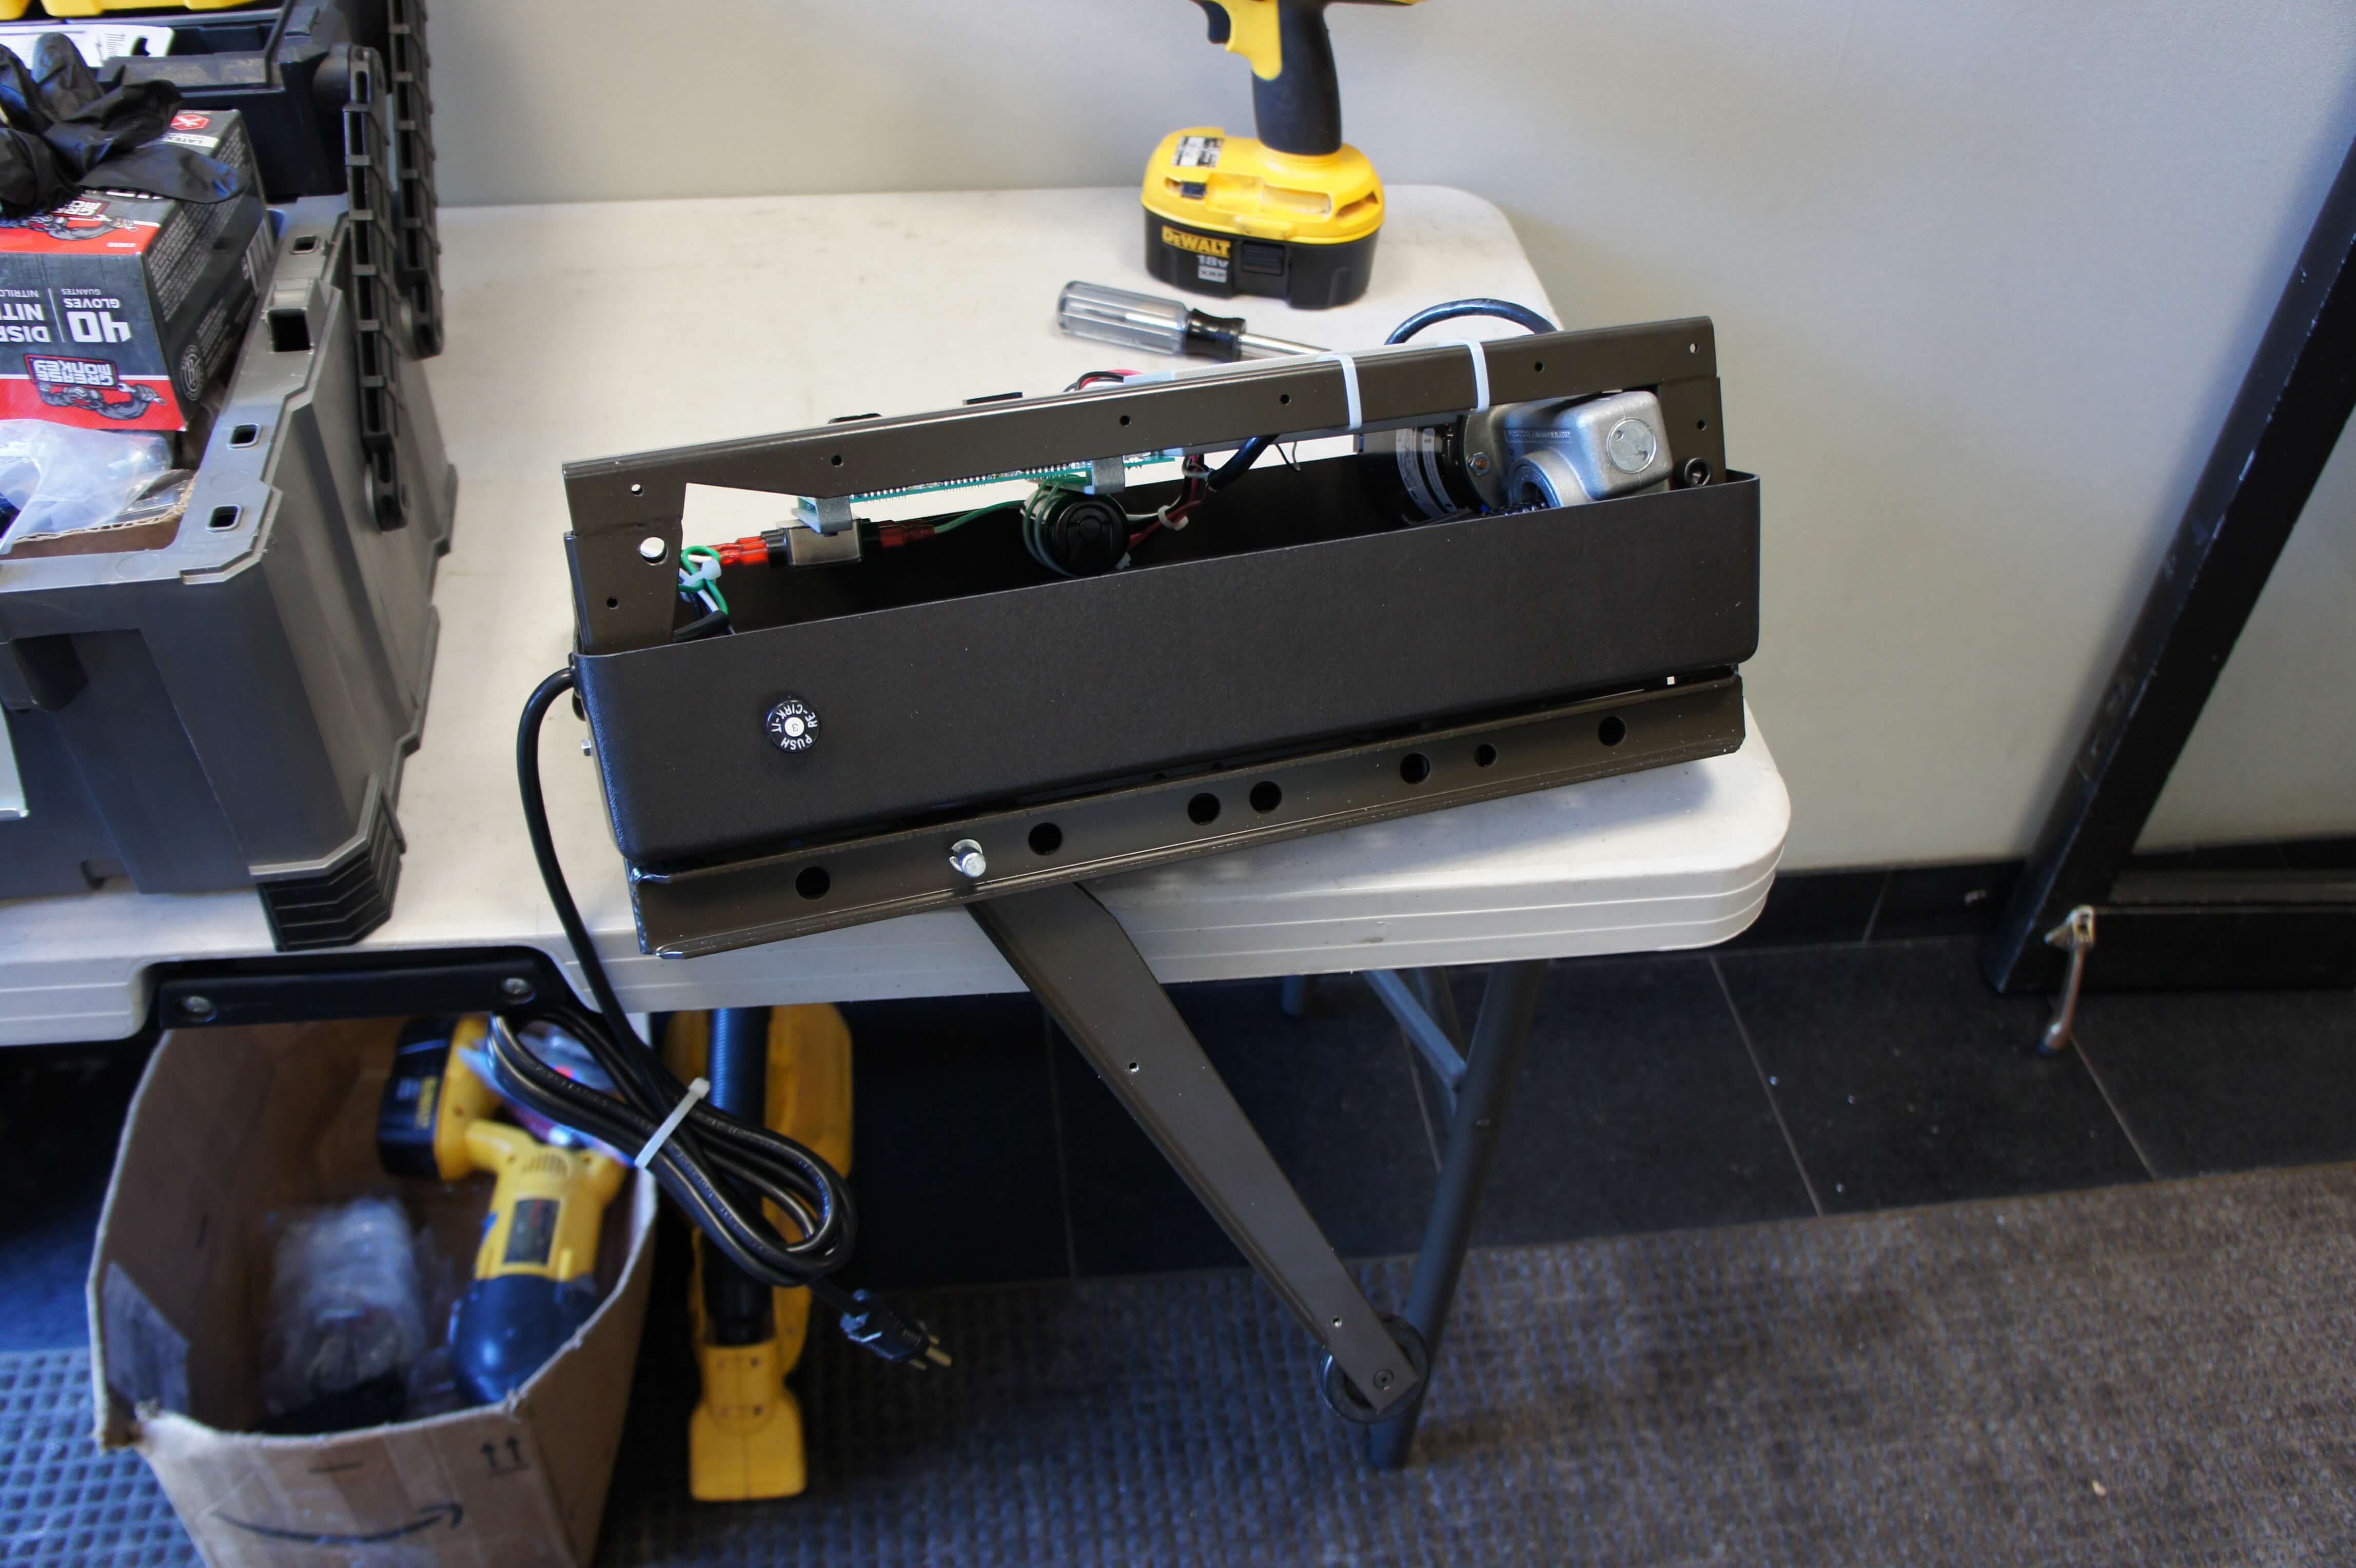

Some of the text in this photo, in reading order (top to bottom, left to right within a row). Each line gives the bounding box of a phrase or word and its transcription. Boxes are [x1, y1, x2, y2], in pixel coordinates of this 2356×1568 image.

[63, 298, 121, 309] GLOVES
[0, 303, 45, 321] NIT
[67, 311, 132, 343] 40
[33, 359, 112, 376] MONKEY
[36, 371, 114, 386] GREASE
[780, 734, 813, 750] PUSH
